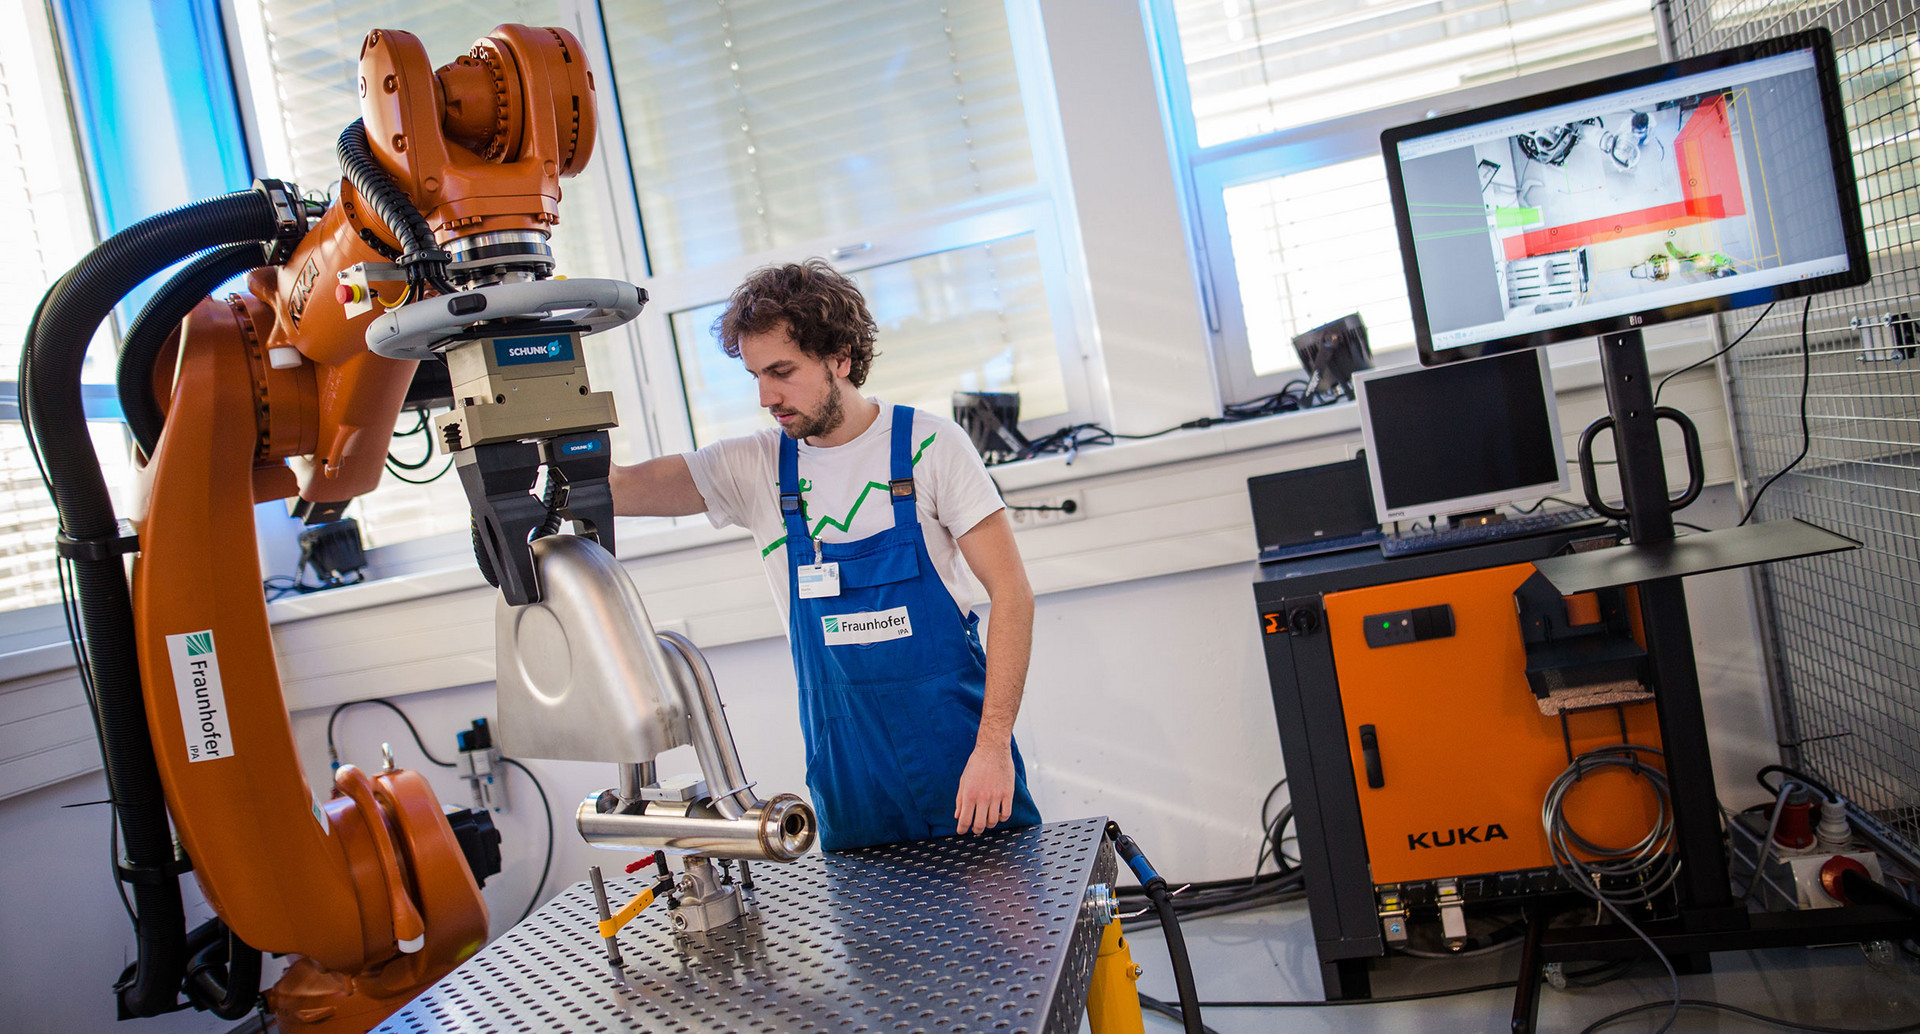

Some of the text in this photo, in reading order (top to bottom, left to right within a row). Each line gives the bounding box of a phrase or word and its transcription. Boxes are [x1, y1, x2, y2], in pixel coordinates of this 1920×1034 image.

[288, 257, 320, 331] KUKA
[509, 345, 548, 357] SCHUNK
[841, 615, 906, 632] Fraunhofer
[190, 660, 221, 757] Fraunhofer
[189, 744, 200, 760] IPA
[1407, 823, 1509, 851] KUKA
